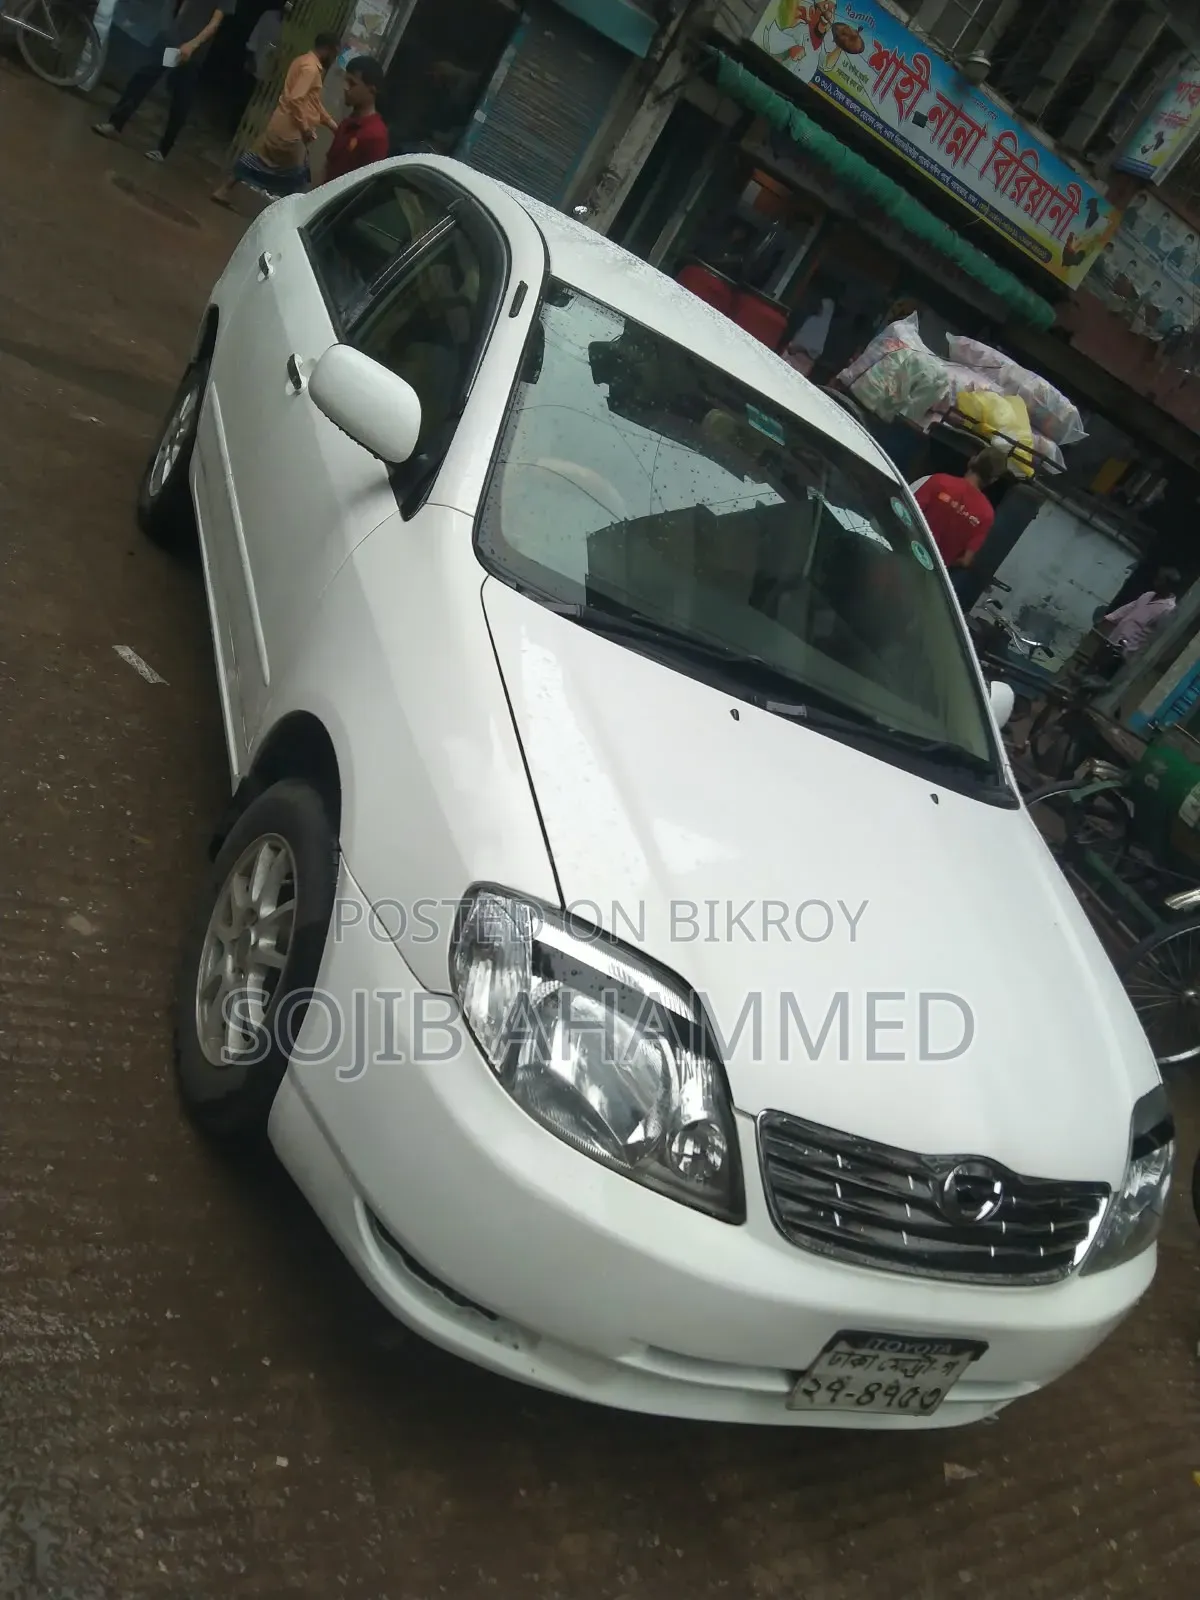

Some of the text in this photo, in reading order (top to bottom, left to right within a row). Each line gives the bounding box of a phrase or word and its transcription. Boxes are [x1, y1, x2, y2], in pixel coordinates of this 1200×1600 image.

[867, 38, 932, 127] শাহী
[927, 88, 988, 169] নান্না
[978, 129, 1082, 240] বিরিয়ানী
